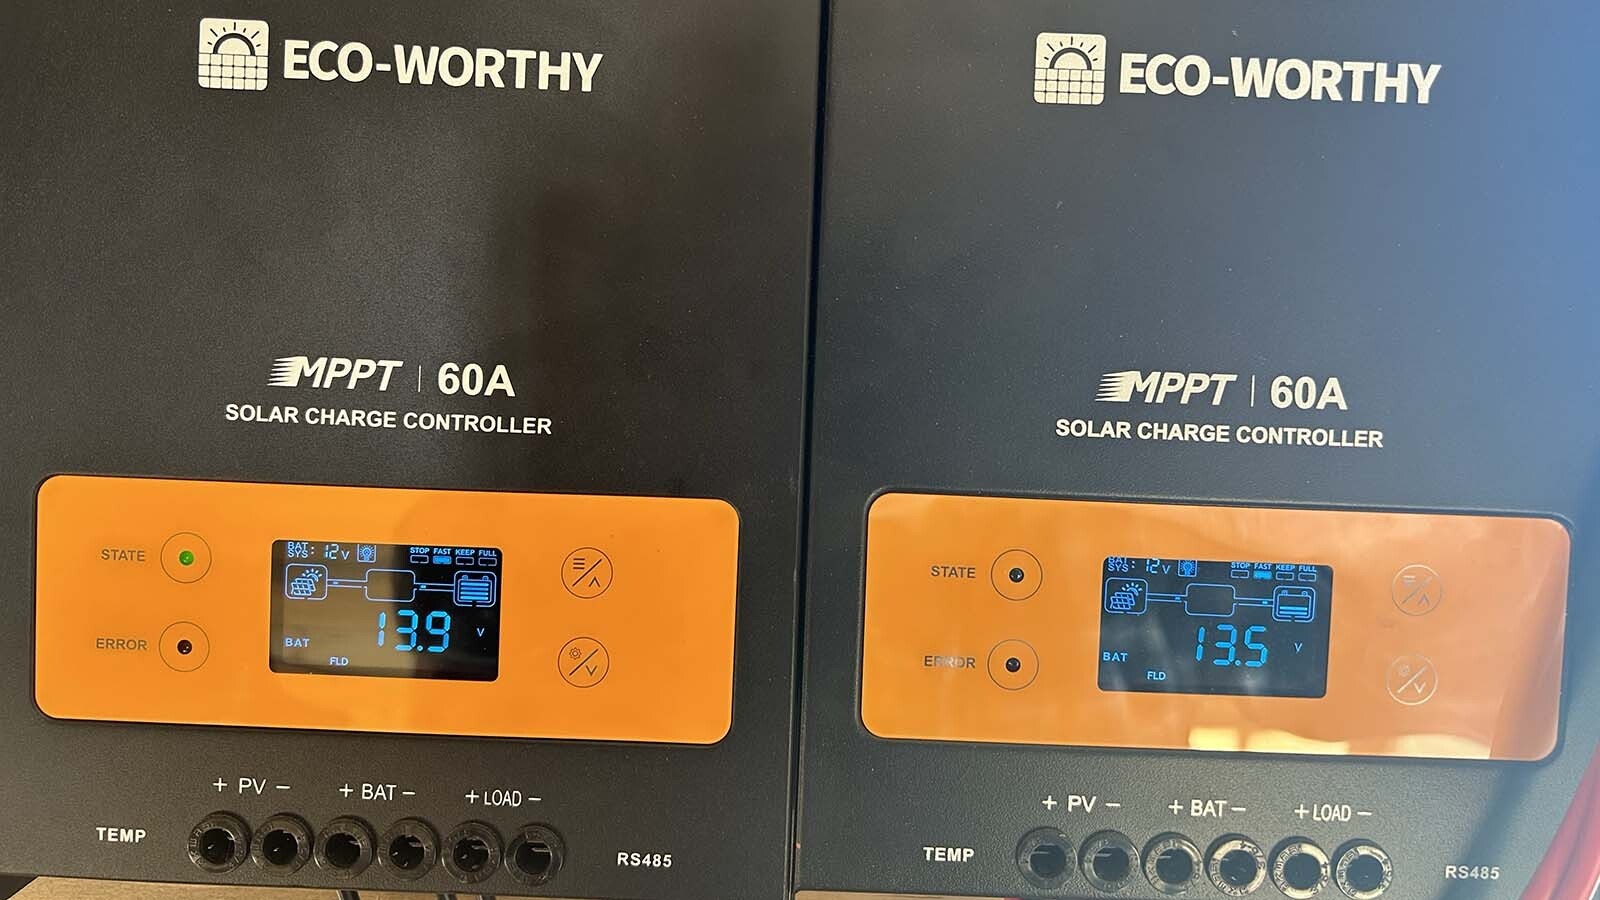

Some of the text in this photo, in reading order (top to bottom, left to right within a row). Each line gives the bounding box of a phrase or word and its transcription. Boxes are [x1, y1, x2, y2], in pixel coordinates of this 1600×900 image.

[283, 39, 604, 92] ECO-WORTHY
[1119, 52, 1442, 104] ECO-WORTHY
[276, 355, 516, 397] MPPT 60A
[1104, 370, 1348, 411] MPPT 60A
[225, 403, 552, 436] SOLAR CHARGE CONTROLLER
[1055, 418, 1384, 448] SOLAR CHARGE CONTROLLER
[287, 541, 309, 550] BAT
[409, 546, 497, 557] STOP FAST KEEP FULL
[101, 549, 145, 562] STATE
[931, 565, 976, 579] STATE
[1230, 561, 1317, 573] STOP FAST KEEP FULL
[376, 609, 451, 653] 13.9
[96, 638, 147, 651] ERROR
[284, 637, 310, 648] BAT
[1195, 624, 1268, 668] 13.5
[329, 656, 349, 666] FLD
[924, 655, 976, 669] ERROR
[1102, 652, 1128, 662] BAT
[1146, 671, 1166, 681] FLD
[238, 777, 267, 795] PV
[361, 783, 398, 801] BAT
[484, 789, 523, 807] LOAD
[1067, 794, 1097, 814] PV
[1190, 799, 1228, 819] BAT
[1312, 803, 1352, 822] LOAD
[95, 826, 147, 843] TEMP
[616, 852, 673, 868] RS485
[922, 846, 975, 863] TEMP
[1445, 864, 1500, 880] RS485
